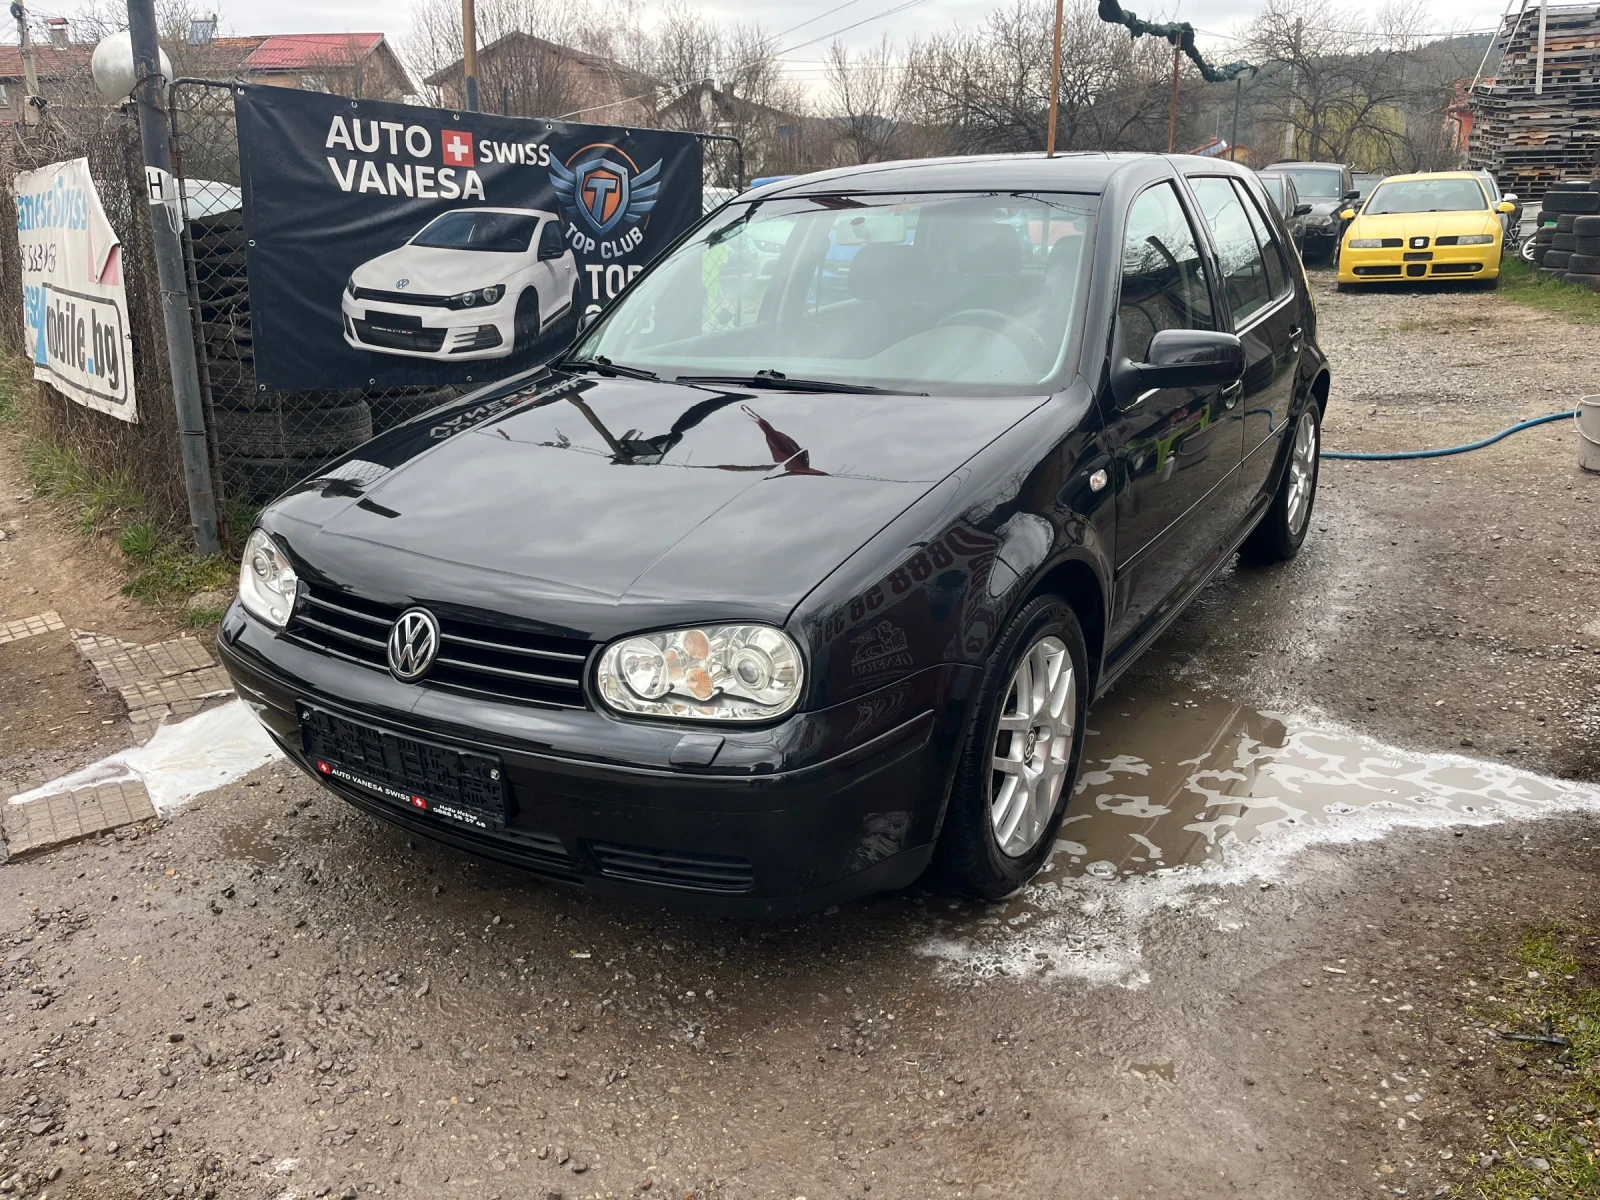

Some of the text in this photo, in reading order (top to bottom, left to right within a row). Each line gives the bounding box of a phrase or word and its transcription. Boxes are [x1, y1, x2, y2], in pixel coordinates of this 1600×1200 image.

[325, 115, 550, 166] AUTO SWISS
[327, 156, 486, 200] VANESA
[565, 222, 644, 259] TOP CLUB
[331, 769, 411, 802] AUTO VANESA SWISS
